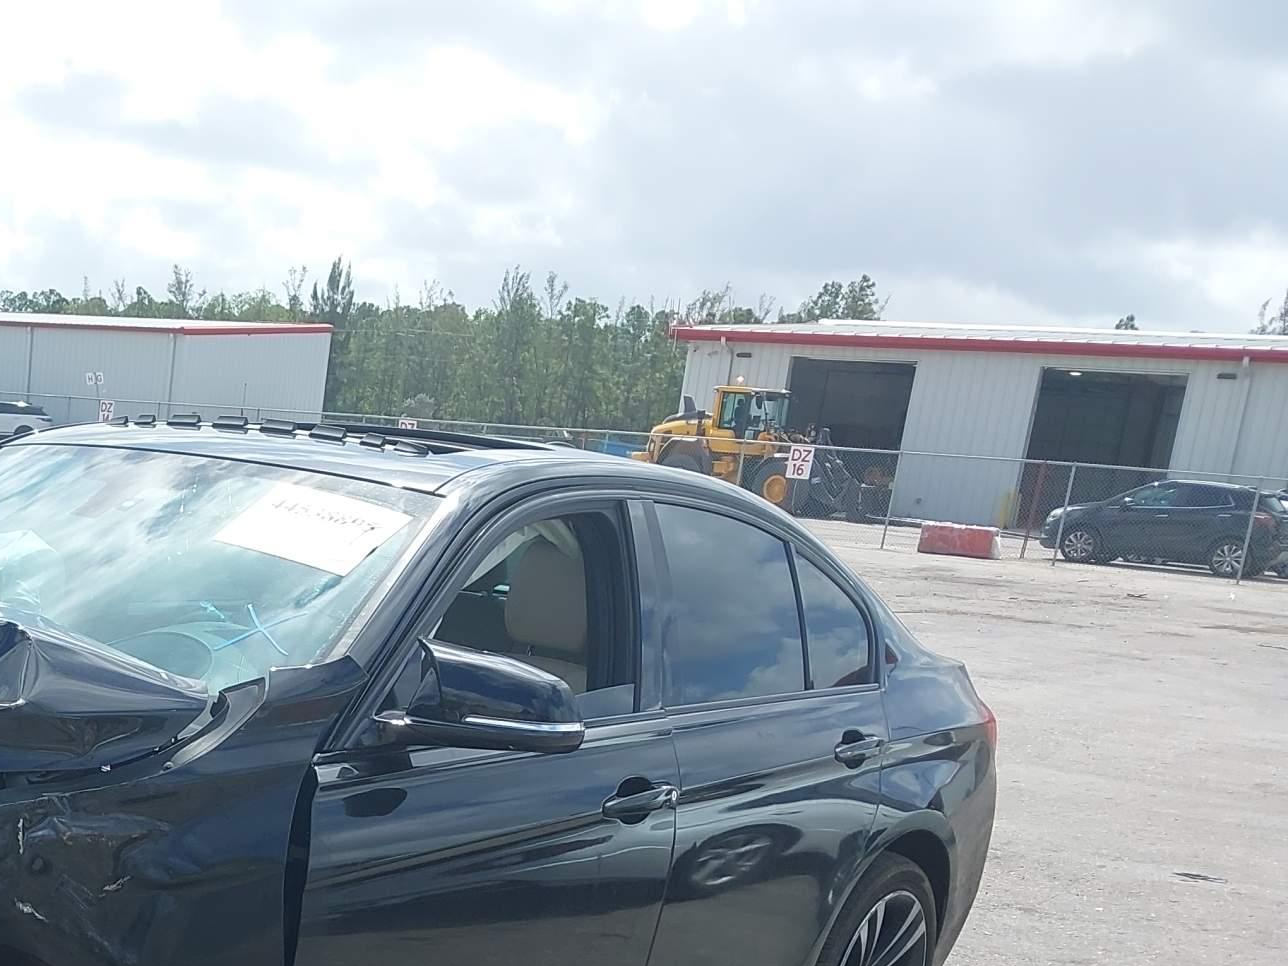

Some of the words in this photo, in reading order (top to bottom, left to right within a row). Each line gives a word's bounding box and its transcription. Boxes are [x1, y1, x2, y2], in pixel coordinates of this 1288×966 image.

[101, 402, 113, 413] DZ
[791, 448, 813, 463] DZ
[792, 463, 805, 476] 16
